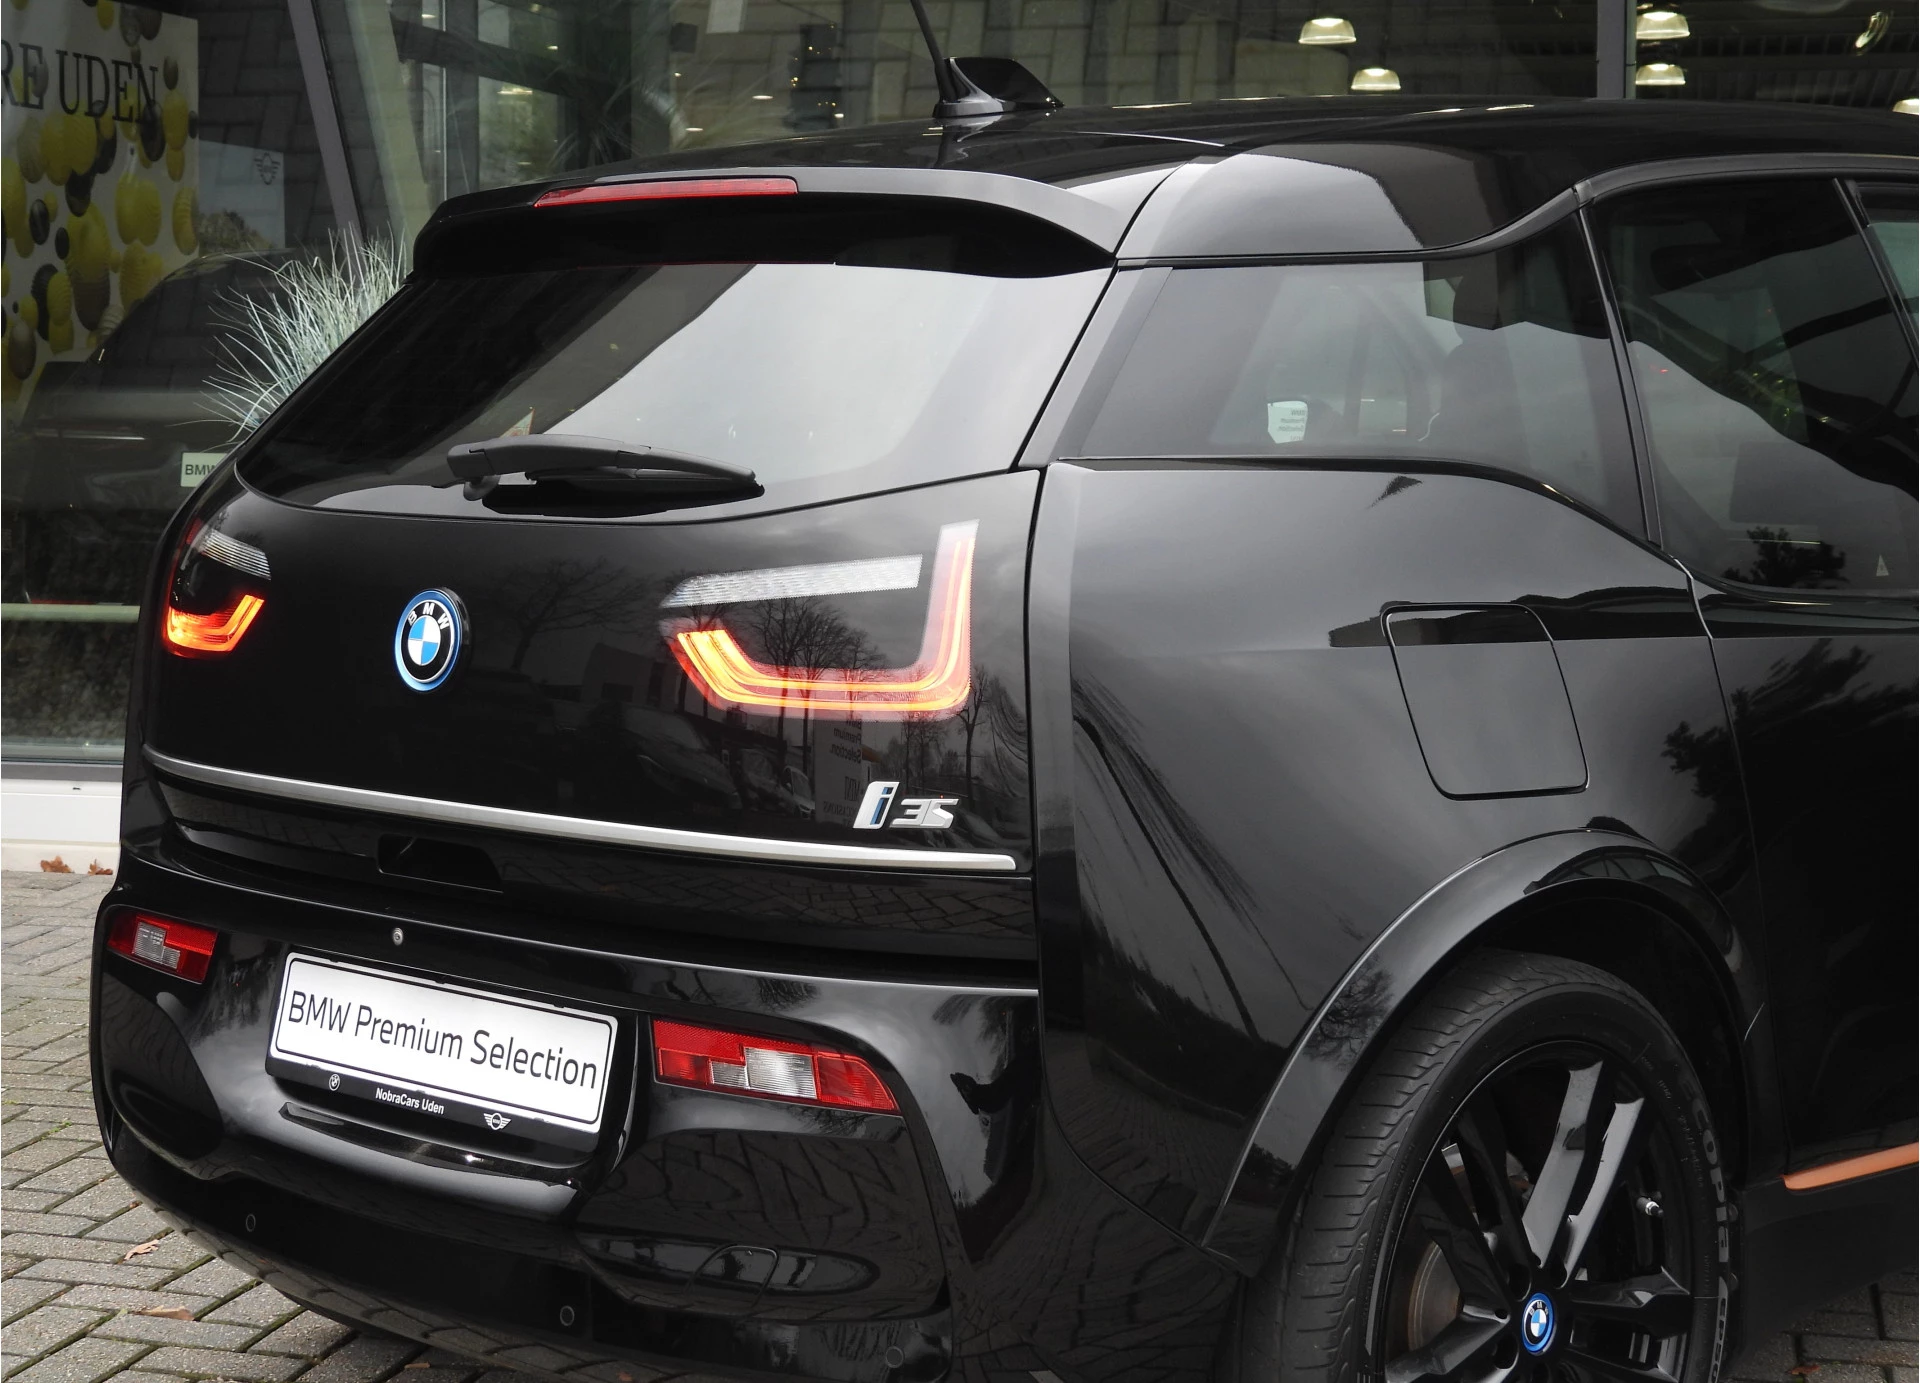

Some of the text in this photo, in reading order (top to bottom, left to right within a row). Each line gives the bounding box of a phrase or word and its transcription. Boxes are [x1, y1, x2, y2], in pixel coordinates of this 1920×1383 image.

[56, 50, 158, 124] UDEN
[407, 602, 450, 630] BMW
[288, 990, 598, 1089] BMW Premium Selection
[375, 1087, 445, 1115] NobraCars Uden
